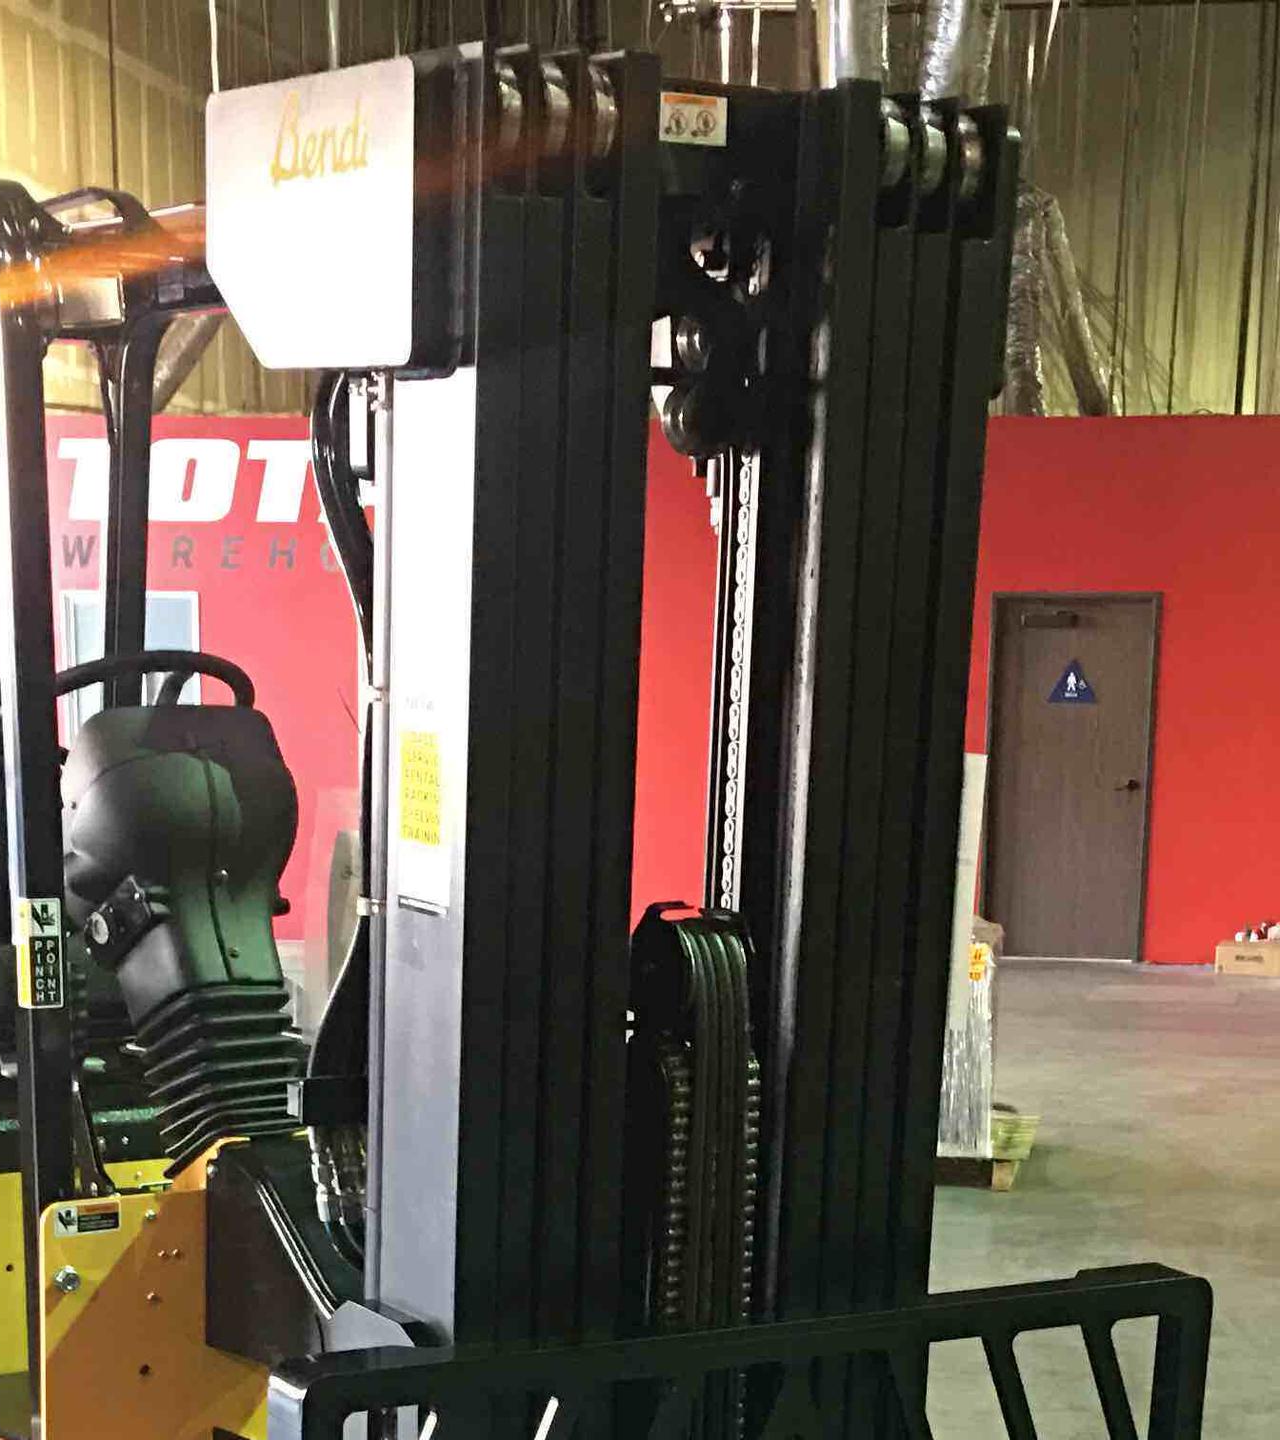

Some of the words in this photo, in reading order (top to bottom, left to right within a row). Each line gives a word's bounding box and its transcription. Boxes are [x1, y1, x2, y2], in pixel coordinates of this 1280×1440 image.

[270, 89, 368, 187] Bendi
[57, 437, 375, 523] TOT
[62, 534, 345, 573] WREHO
[34, 940, 45, 1001] PINCH
[46, 939, 57, 1001] POINT
